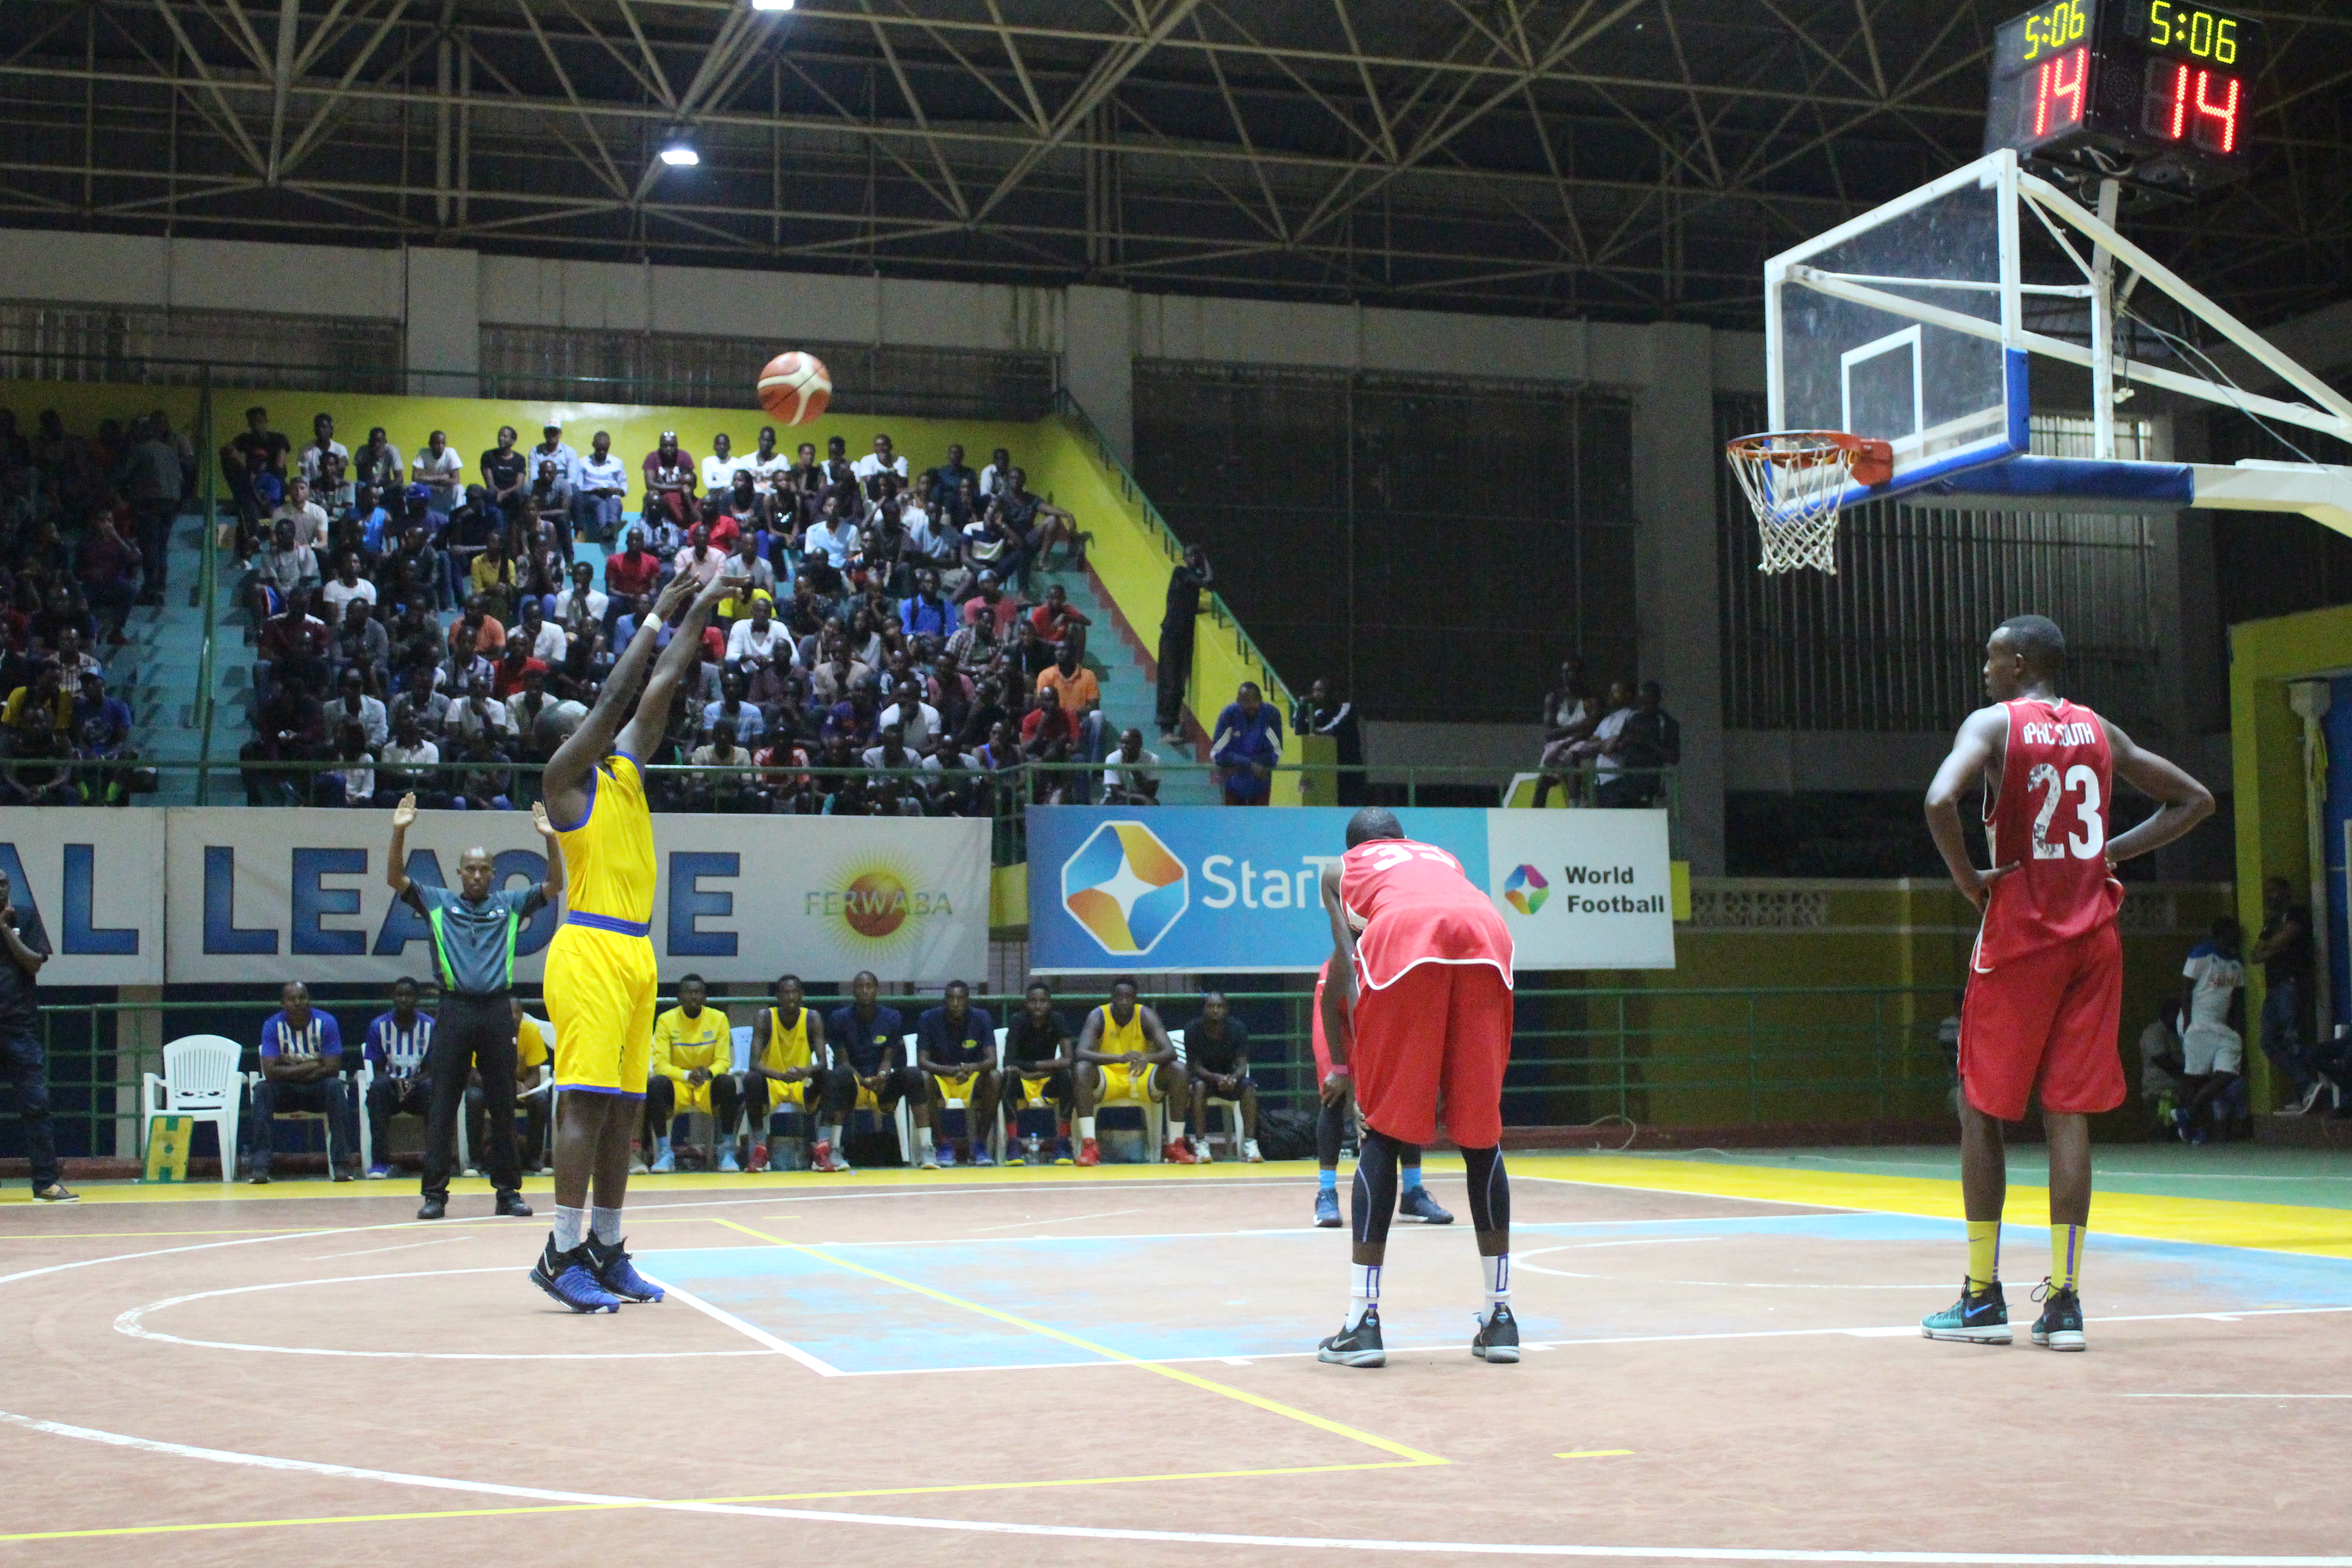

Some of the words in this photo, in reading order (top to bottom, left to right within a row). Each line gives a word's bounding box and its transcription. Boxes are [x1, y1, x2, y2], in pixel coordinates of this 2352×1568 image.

[2024, 0, 2086, 60] 5:06
[2150, 0, 2237, 64] 5:06
[2034, 47, 2088, 136] 14
[2172, 65, 2239, 152] 14
[2027, 763, 2104, 860] 23
[202, 845, 740, 957] LEAGE
[805, 889, 952, 916] FERWABA
[1565, 866, 1634, 884] World
[1567, 895, 1665, 913] Football
